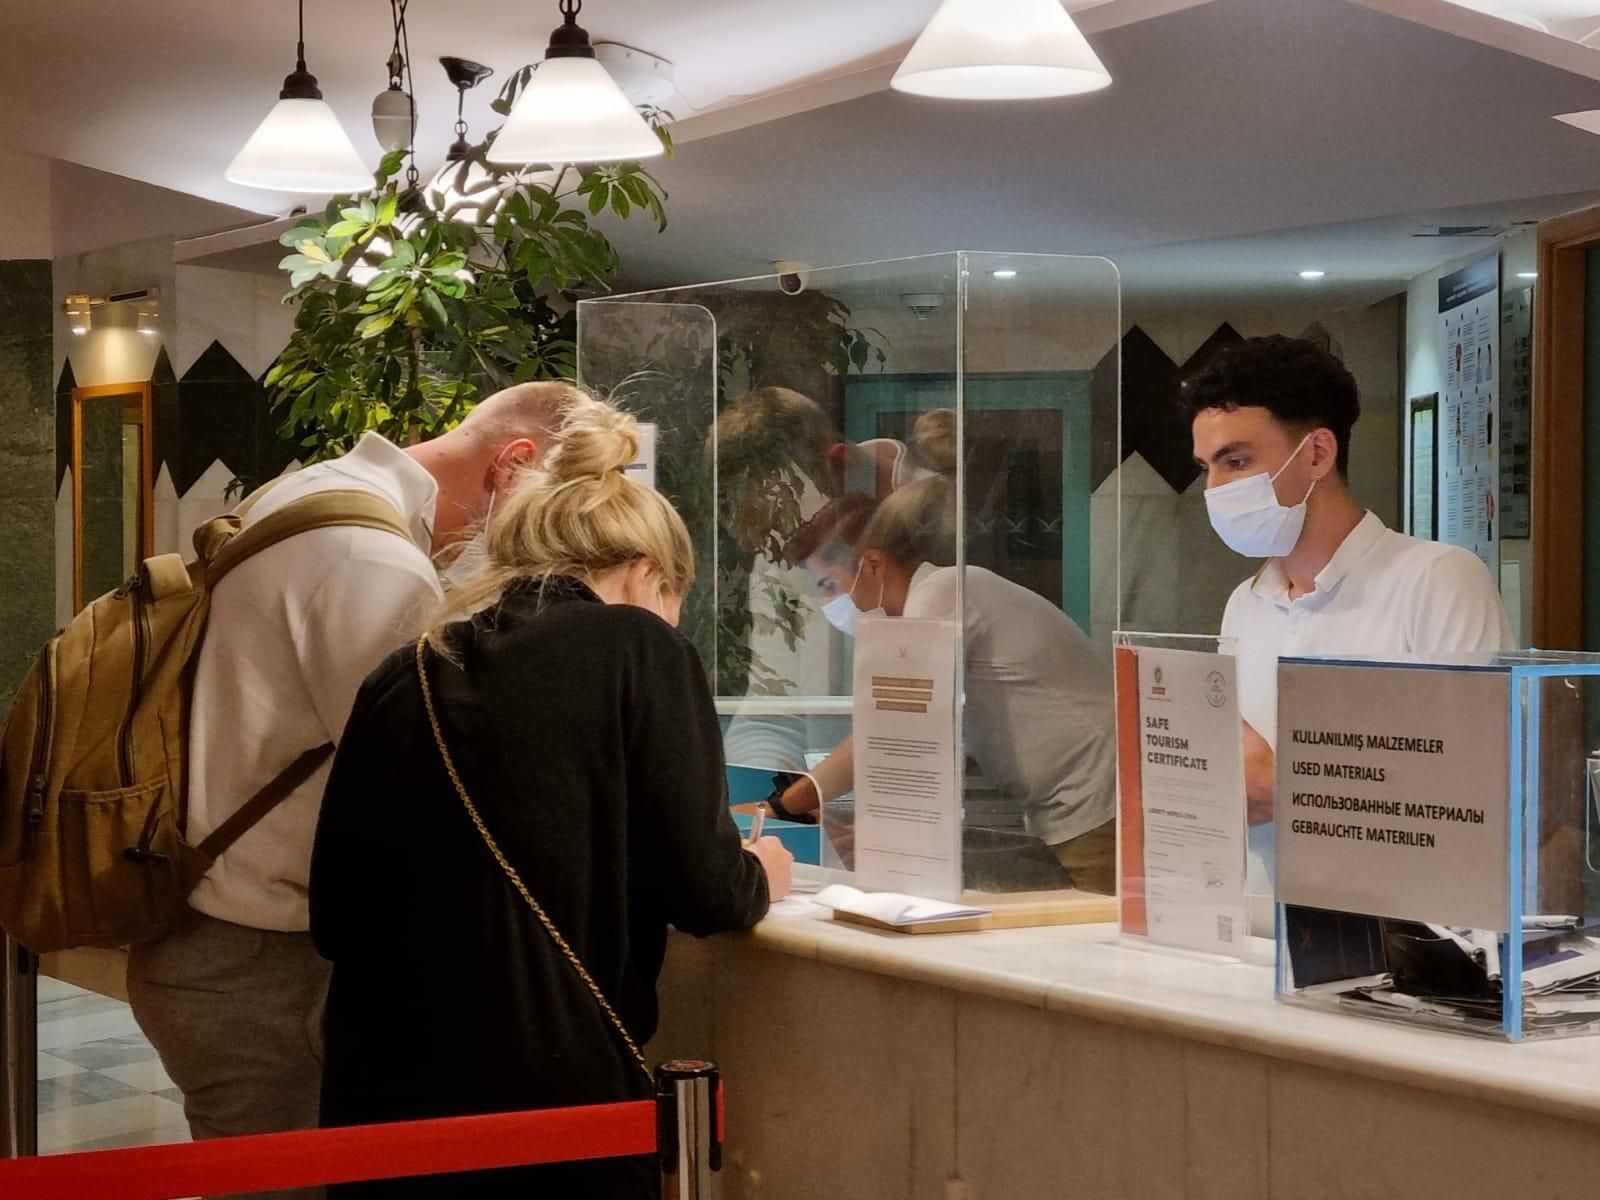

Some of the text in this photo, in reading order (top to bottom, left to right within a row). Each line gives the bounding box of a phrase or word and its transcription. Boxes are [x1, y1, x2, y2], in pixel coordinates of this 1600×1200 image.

[1145, 716, 1169, 730] SAFE
[1146, 734, 1189, 751] TOURISM
[1292, 729, 1444, 754] KULLANILMIŞ MALZEMELER
[1147, 751, 1208, 771] CERTIFICATE
[1292, 761, 1385, 782] USED MATERIALS
[1292, 792, 1485, 824] ИСПОЛЬЗОВАННЫЕ МАТЕРИАЛЫ
[1291, 819, 1436, 848] GEBRAUCHTE MATERILIEN
